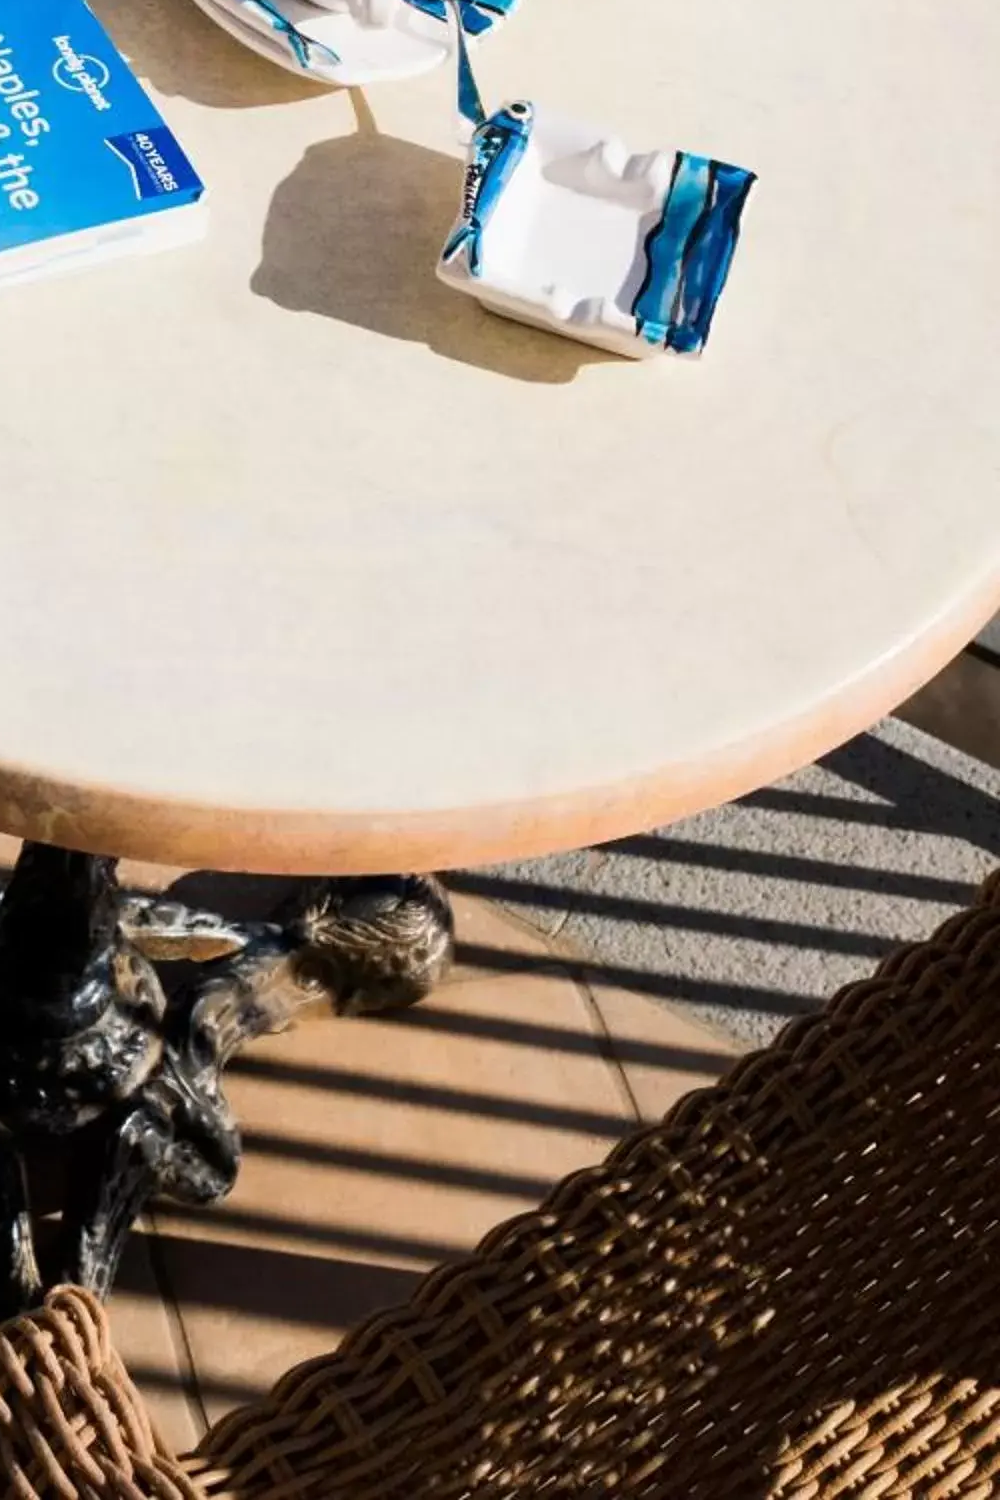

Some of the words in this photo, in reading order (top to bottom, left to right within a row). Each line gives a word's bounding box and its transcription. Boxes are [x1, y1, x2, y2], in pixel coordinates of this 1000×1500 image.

[51, 35, 86, 75] lonely
[75, 69, 112, 112] planet
[135, 132, 154, 151] 40
[146, 148, 180, 191] YEARS
